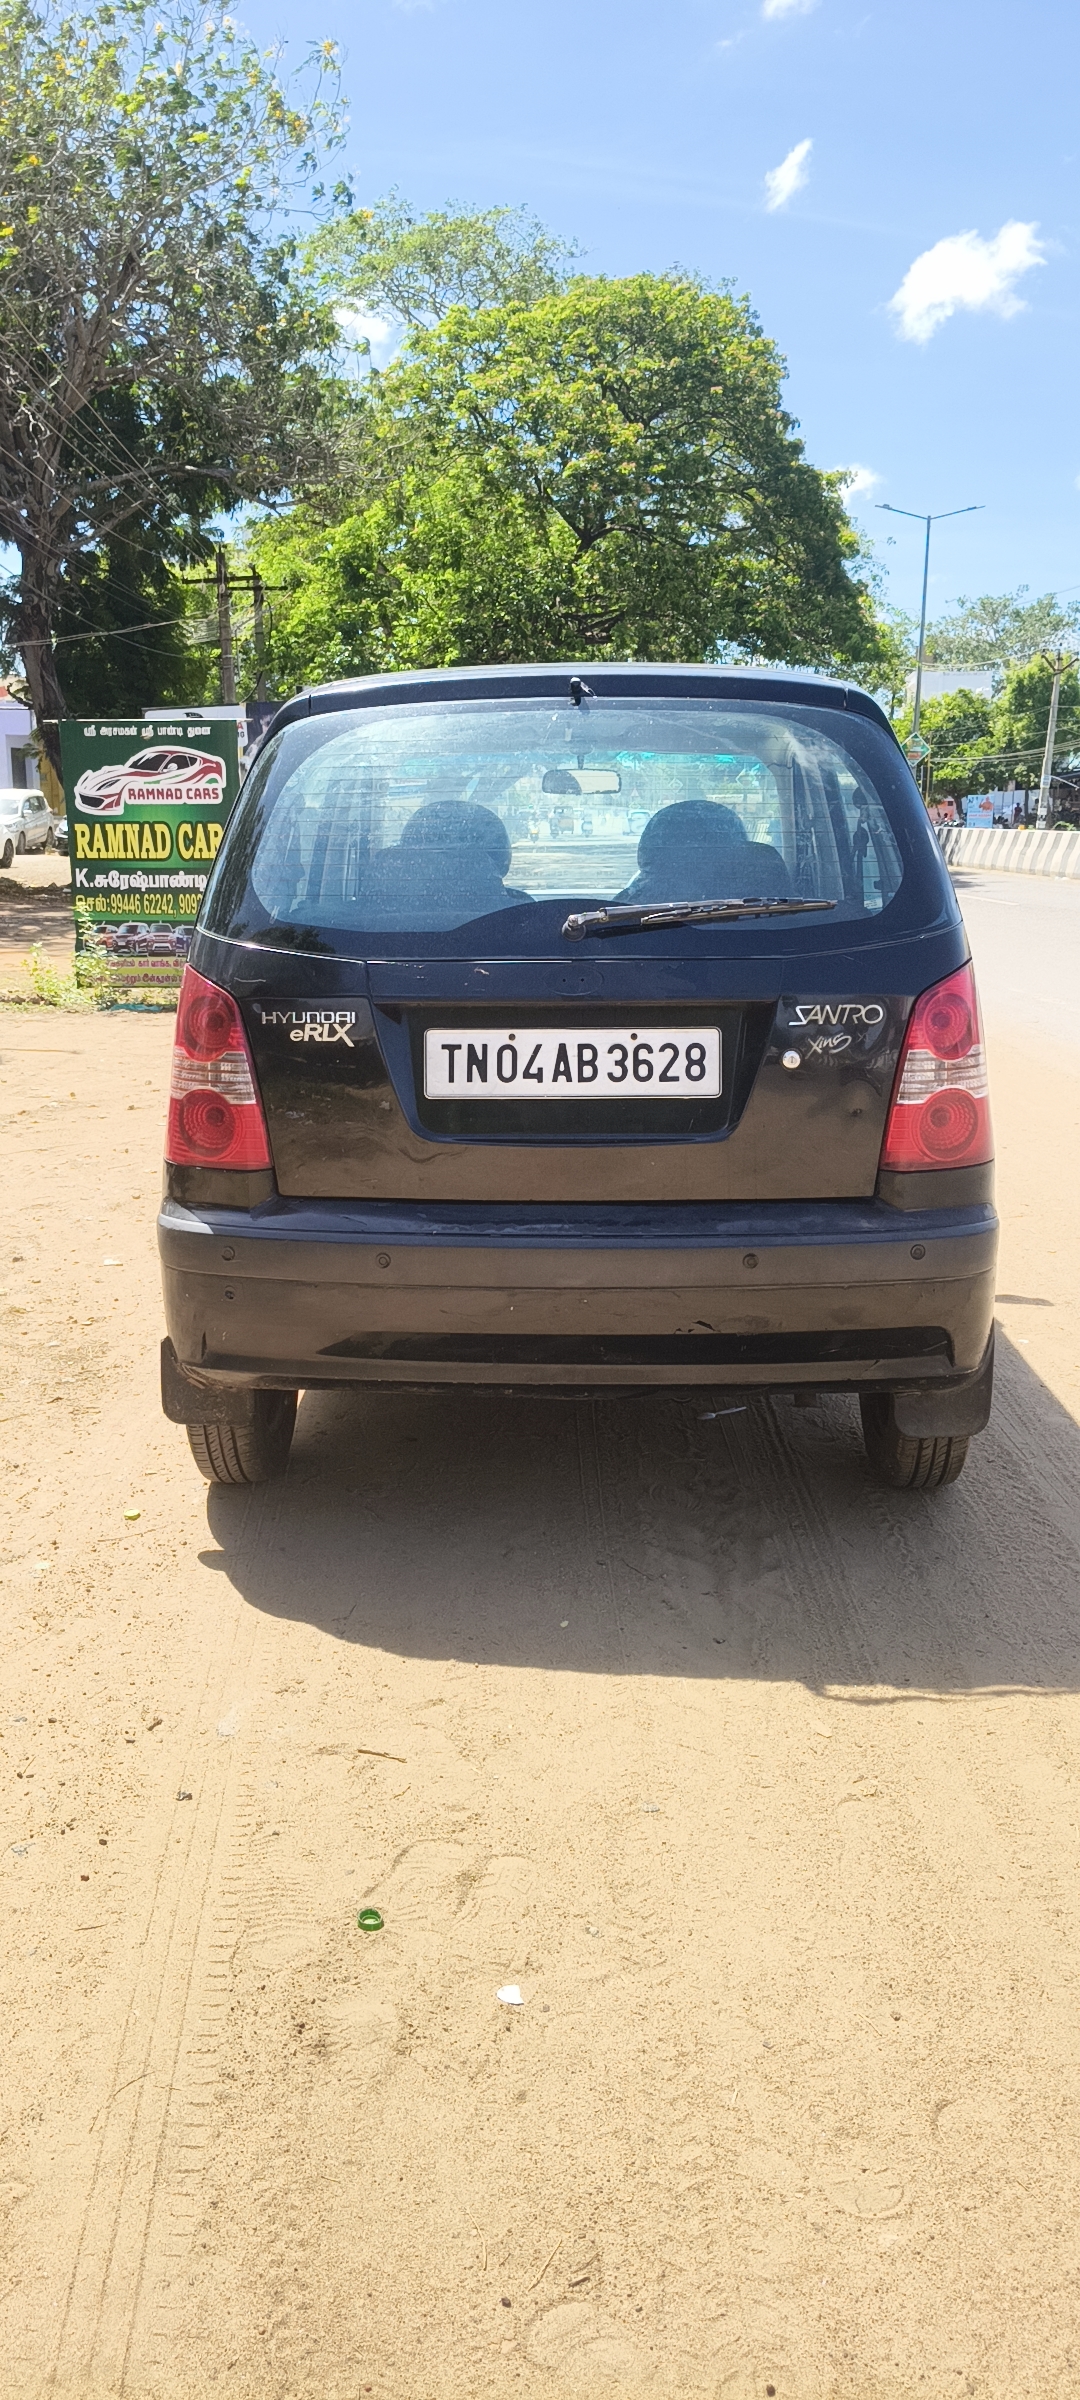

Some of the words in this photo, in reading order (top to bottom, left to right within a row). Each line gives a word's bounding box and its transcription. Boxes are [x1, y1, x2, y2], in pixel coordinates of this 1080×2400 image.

[128, 788, 183, 800] RAMNAD
[186, 787, 220, 800] CARS
[74, 823, 172, 859] RAMNAD
[261, 1011, 356, 1024] HYUNDAI
[788, 1004, 884, 1026] SANTRO
[289, 1023, 355, 1047] eRLX
